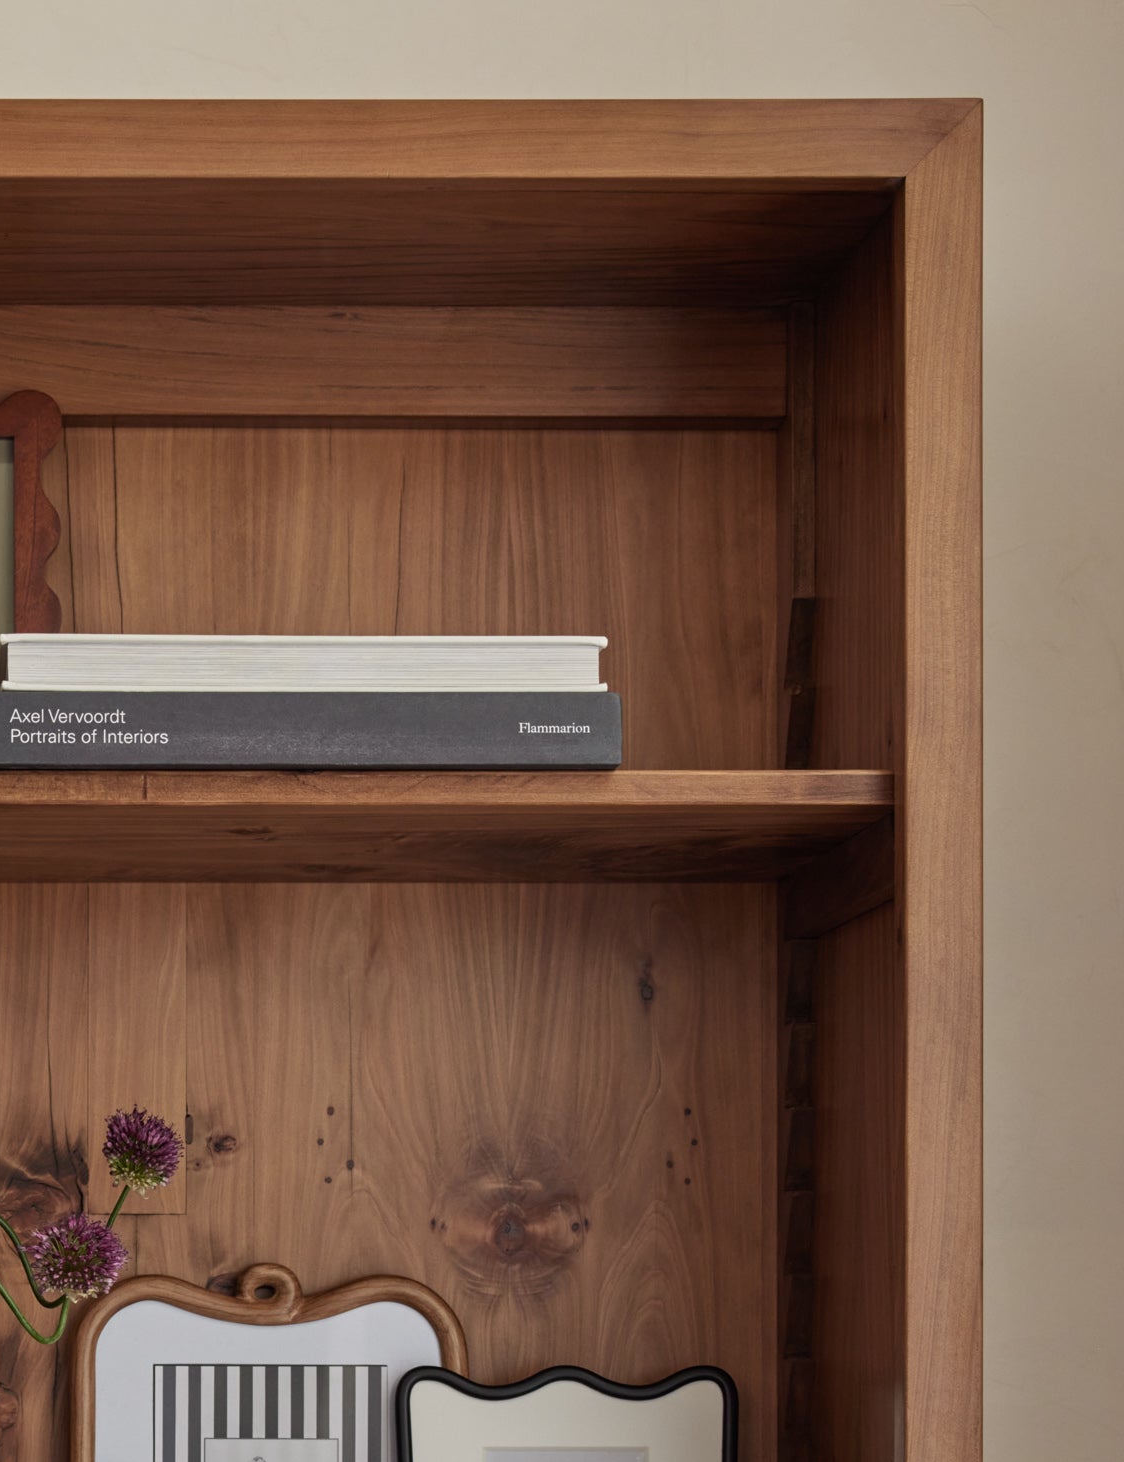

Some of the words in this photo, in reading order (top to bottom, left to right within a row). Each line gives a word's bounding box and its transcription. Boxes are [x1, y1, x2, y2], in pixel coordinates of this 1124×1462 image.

[9, 708, 45, 724] Axel
[47, 708, 127, 724] Vervoordt
[518, 721, 591, 734] Flammarion
[10, 728, 77, 744] Portraits
[81, 728, 98, 744] of
[102, 728, 170, 744] Interiors
